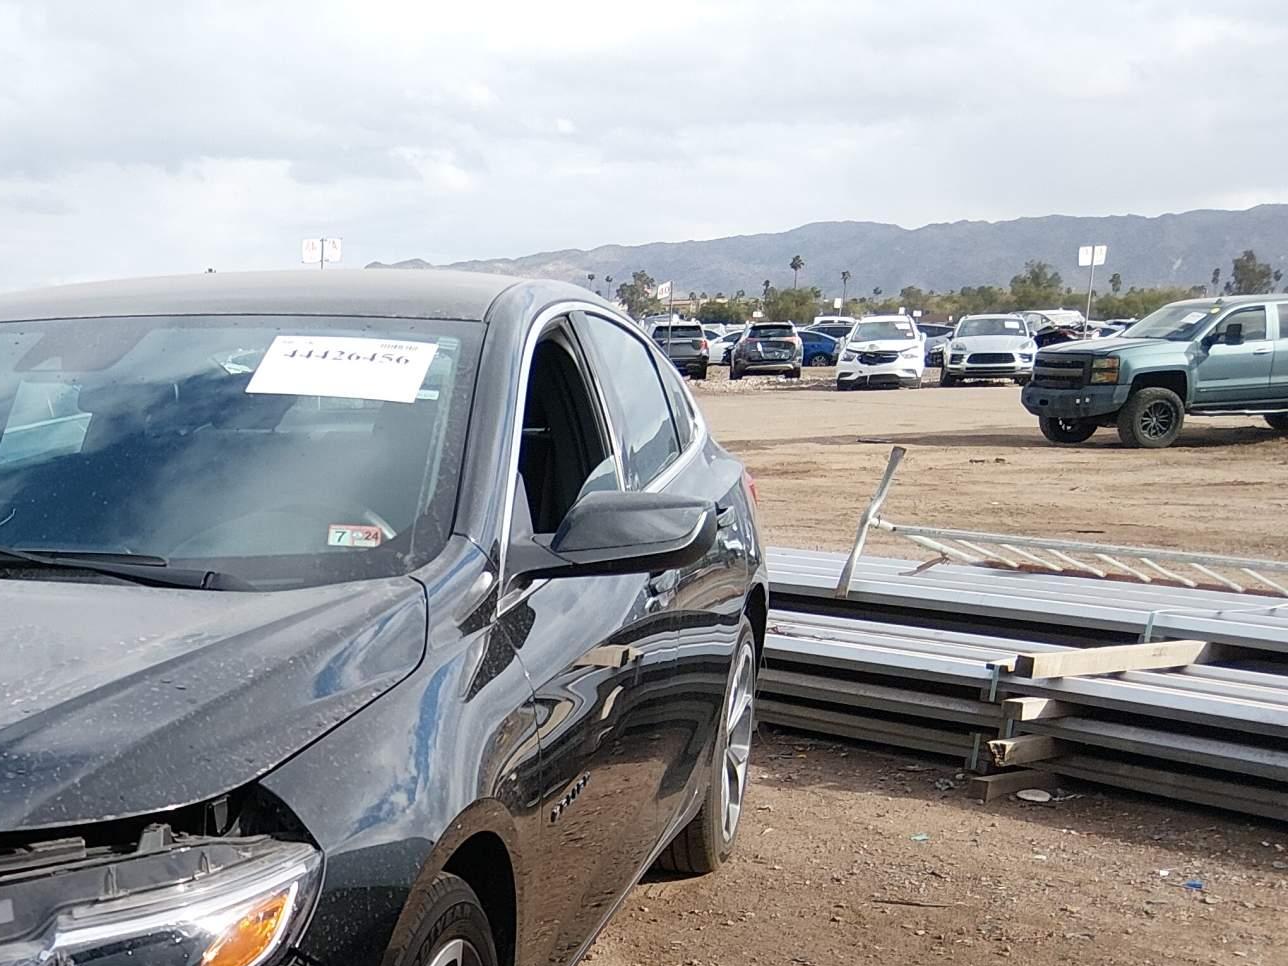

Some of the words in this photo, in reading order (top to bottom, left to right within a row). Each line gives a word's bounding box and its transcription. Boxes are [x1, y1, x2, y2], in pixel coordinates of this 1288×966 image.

[283, 349, 410, 365] 44426456
[335, 530, 347, 543] 7
[364, 531, 379, 541] 24
